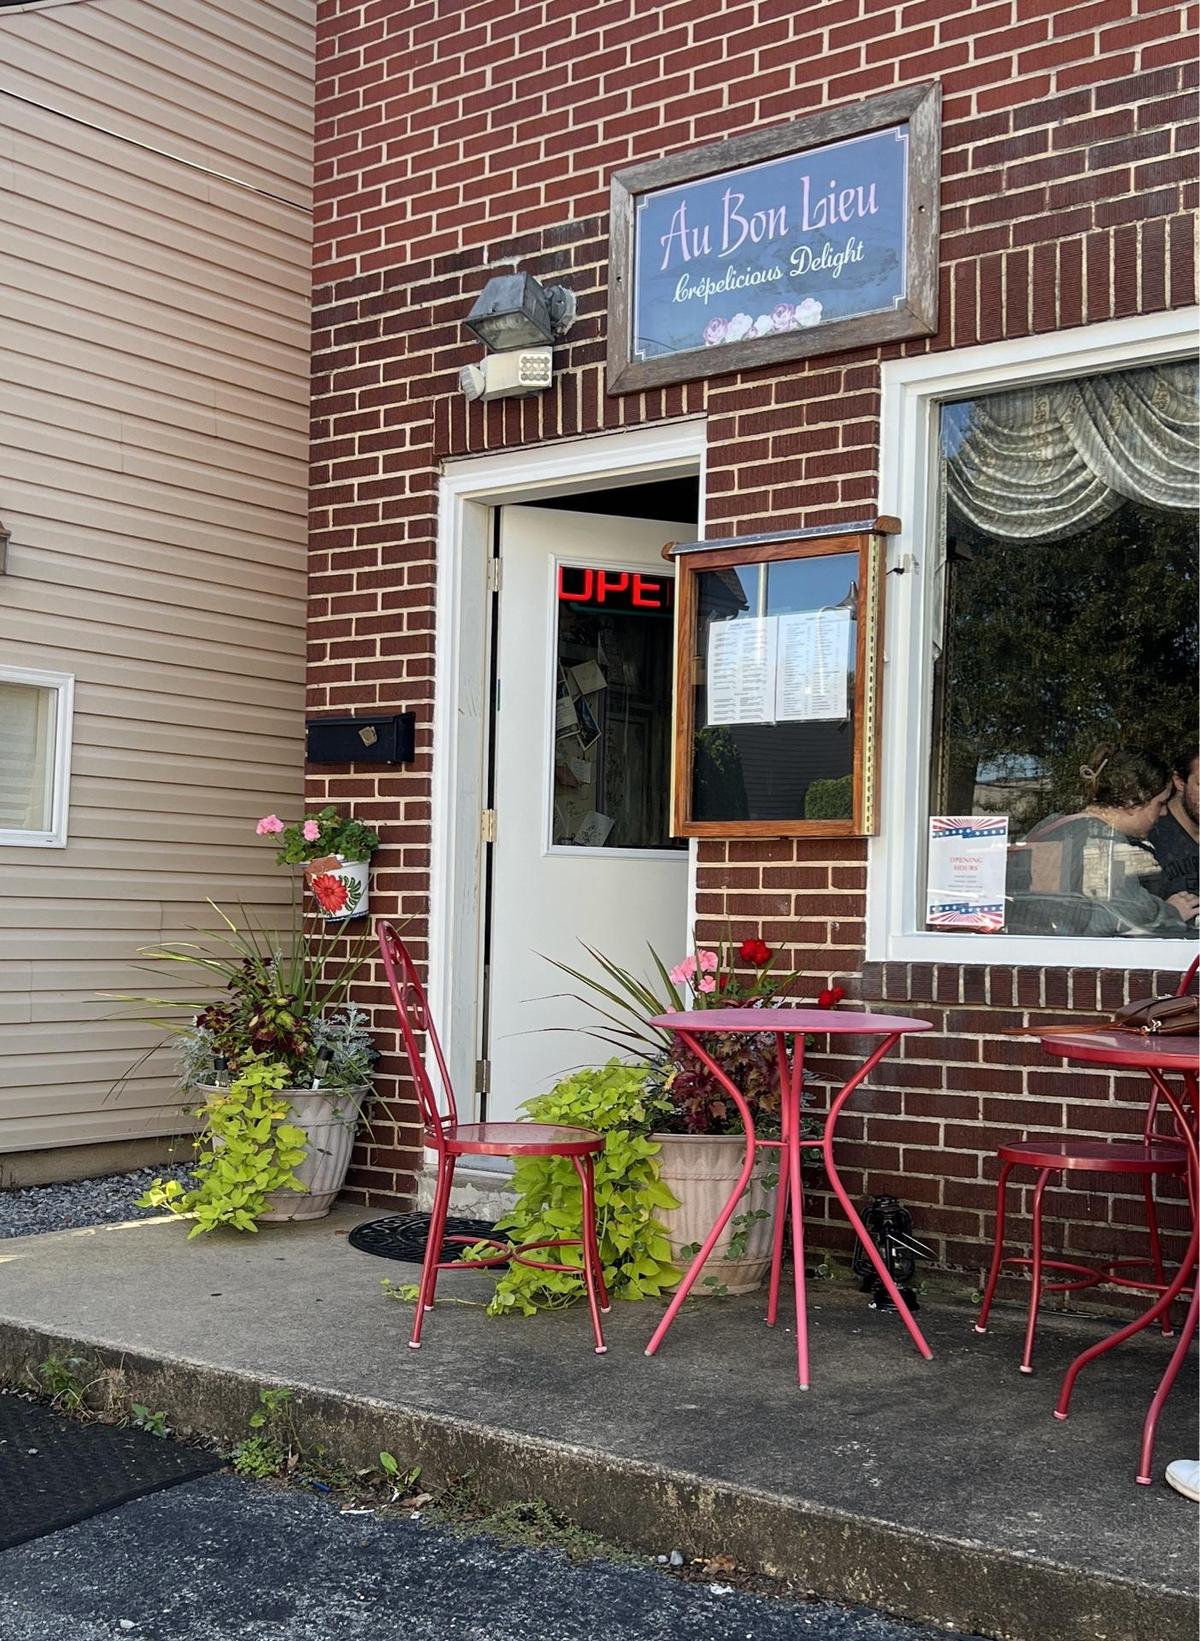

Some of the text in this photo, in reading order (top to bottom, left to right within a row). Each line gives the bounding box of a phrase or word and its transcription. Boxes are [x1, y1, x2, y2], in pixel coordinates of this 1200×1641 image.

[660, 175, 880, 271] Au Bon Lieu
[672, 236, 865, 305] Crêpelicious Delight
[558, 565, 672, 608] OPE
